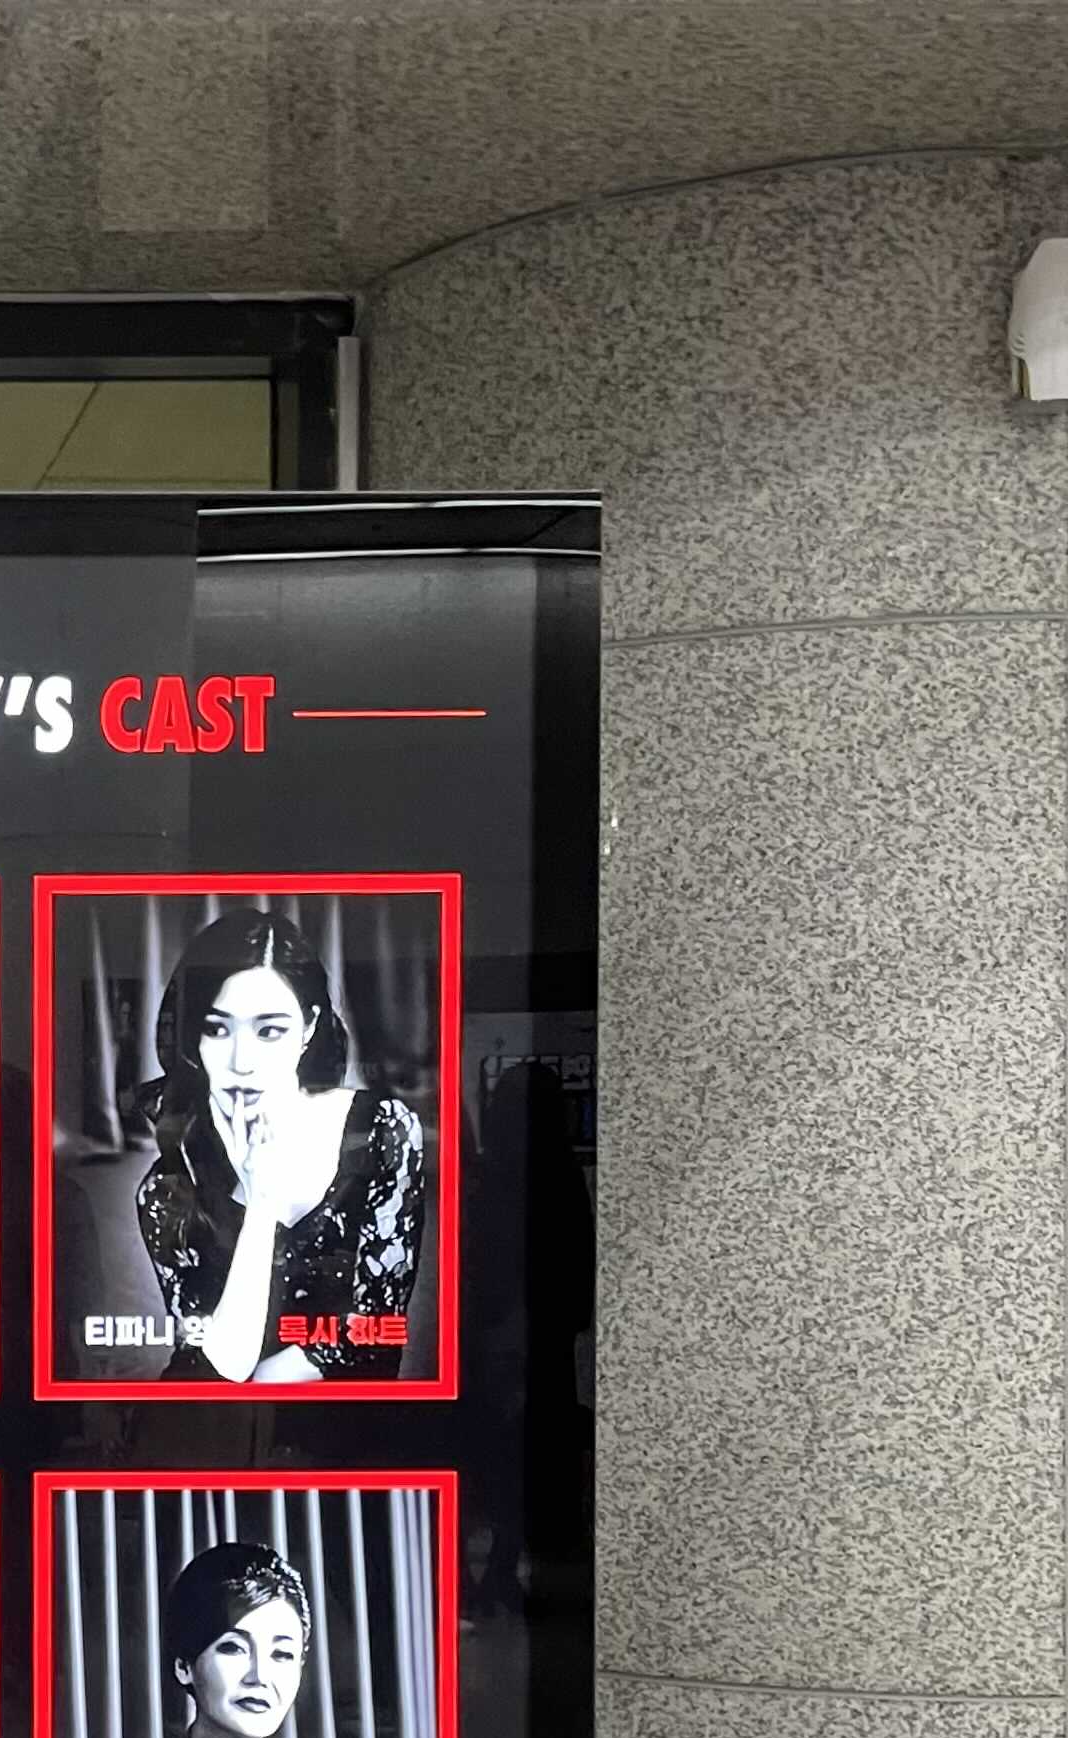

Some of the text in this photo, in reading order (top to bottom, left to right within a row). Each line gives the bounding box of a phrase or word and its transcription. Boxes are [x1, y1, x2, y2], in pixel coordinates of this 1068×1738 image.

[100, 675, 275, 753] CAST
[85, 1315, 175, 1346] 티파니
[279, 1316, 337, 1346] 록시
[346, 1313, 408, 1346] 하트
